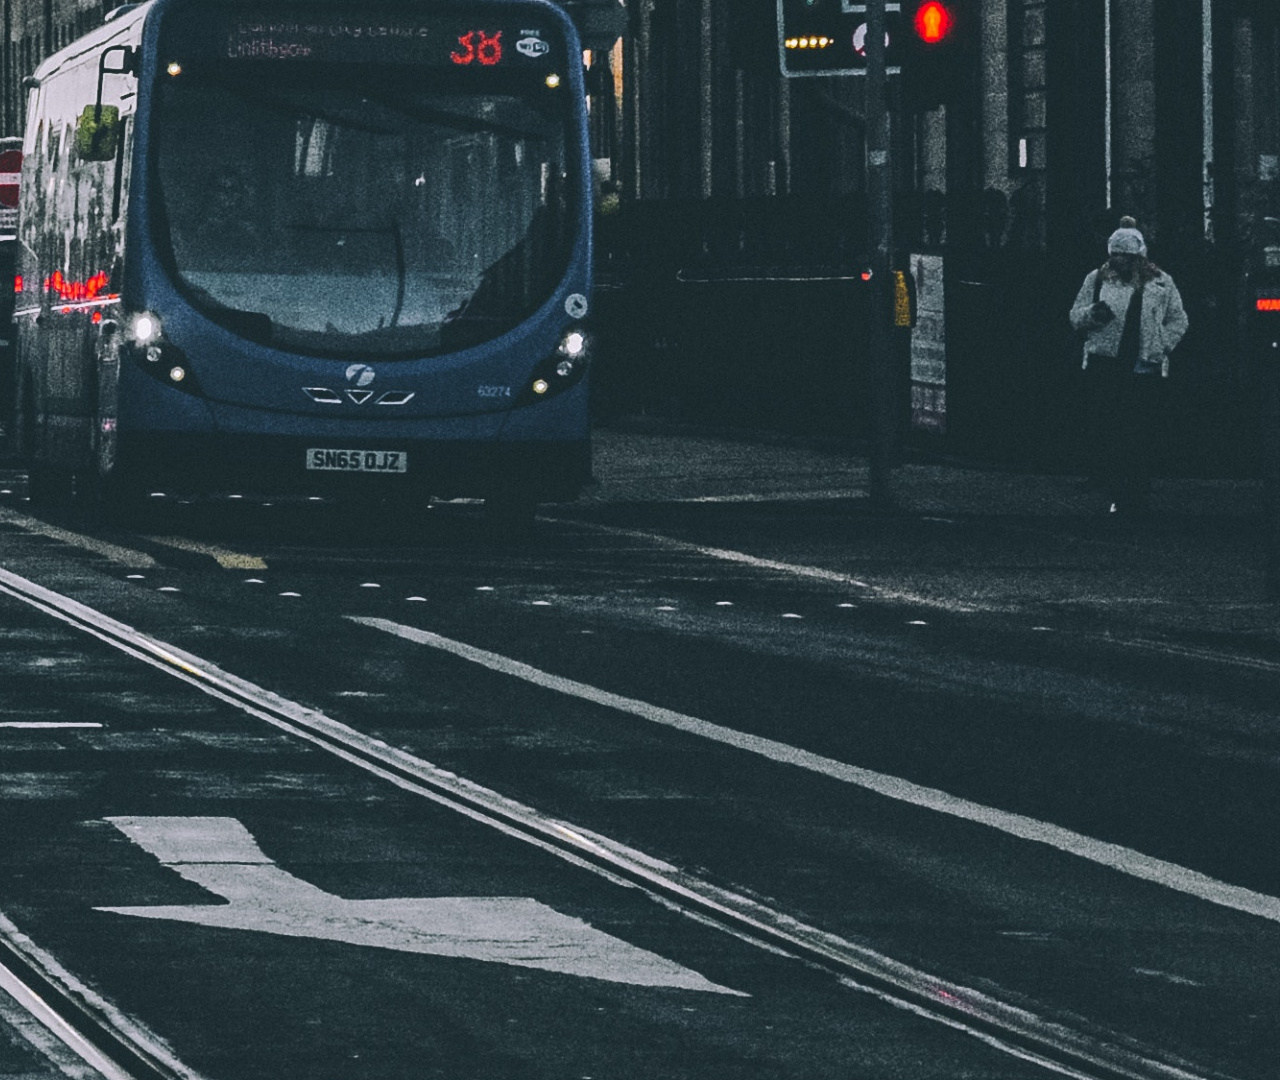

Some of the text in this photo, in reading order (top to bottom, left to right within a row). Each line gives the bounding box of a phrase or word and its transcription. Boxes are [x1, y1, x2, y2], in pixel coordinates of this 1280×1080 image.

[450, 30, 502, 66] 38
[477, 384, 512, 398] 63274
[313, 450, 361, 469] SN65
